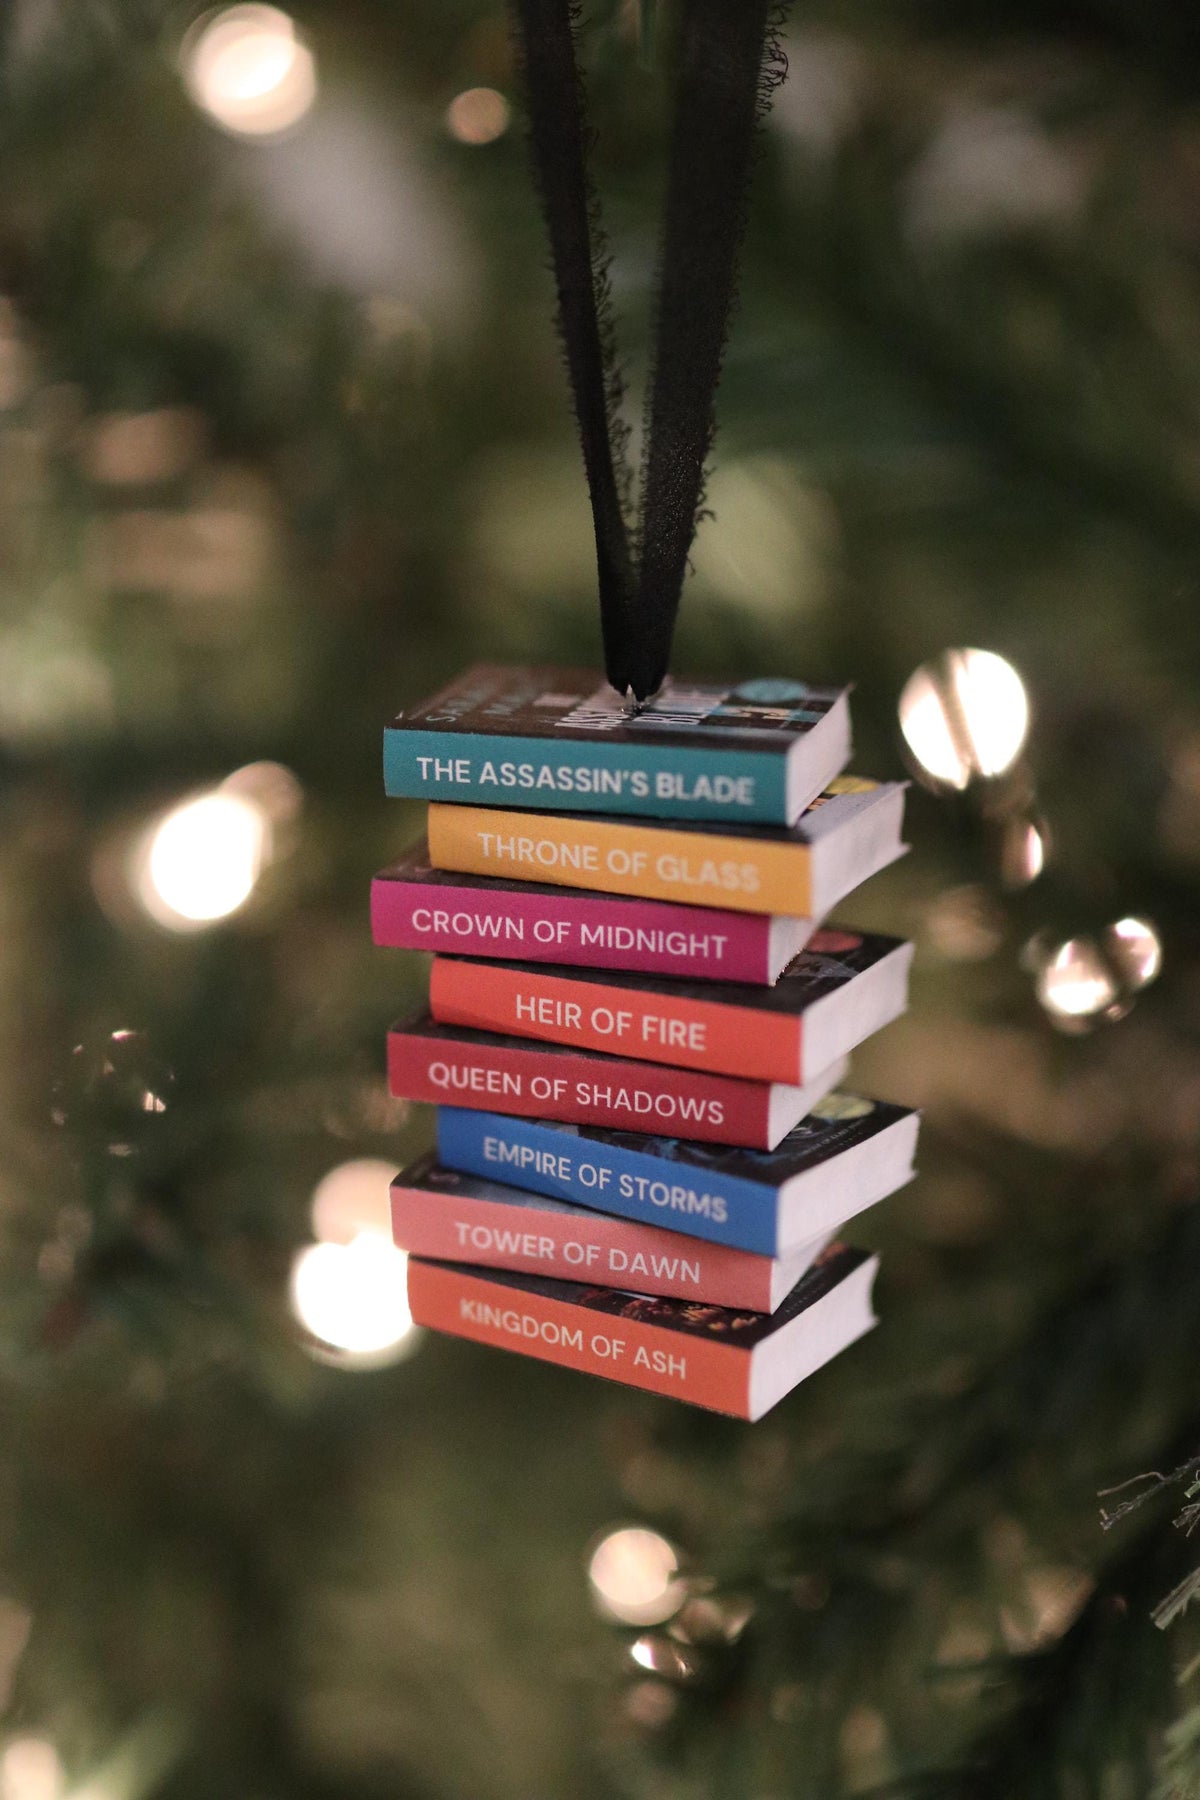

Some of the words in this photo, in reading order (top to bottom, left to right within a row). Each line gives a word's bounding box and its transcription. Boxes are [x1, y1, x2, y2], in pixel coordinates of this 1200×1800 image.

[416, 757, 471, 782] THE
[480, 762, 649, 795] ASSASSIN'S
[656, 772, 754, 804] BLADE
[477, 833, 598, 869] THRONE
[607, 849, 646, 876] OF
[657, 855, 760, 891] GLASS
[412, 909, 524, 940] CROWN
[534, 920, 571, 943] OF
[581, 923, 727, 959] MIDNIGHT
[516, 994, 581, 1029] HEIR
[591, 1007, 632, 1036] OF
[642, 1016, 706, 1050] FIRE
[428, 1062, 522, 1096] QUEEN
[531, 1077, 567, 1101] OF
[576, 1083, 724, 1125] SHADOWS
[484, 1137, 571, 1180] EMPIRE
[579, 1164, 611, 1190] OF
[619, 1174, 727, 1223] STORMS
[455, 1222, 555, 1260] TOWER
[563, 1241, 600, 1266] OF
[608, 1248, 700, 1284] DAWN
[460, 1298, 583, 1350] KINGDOM
[591, 1336, 625, 1360] OF
[633, 1347, 686, 1379] ASH
